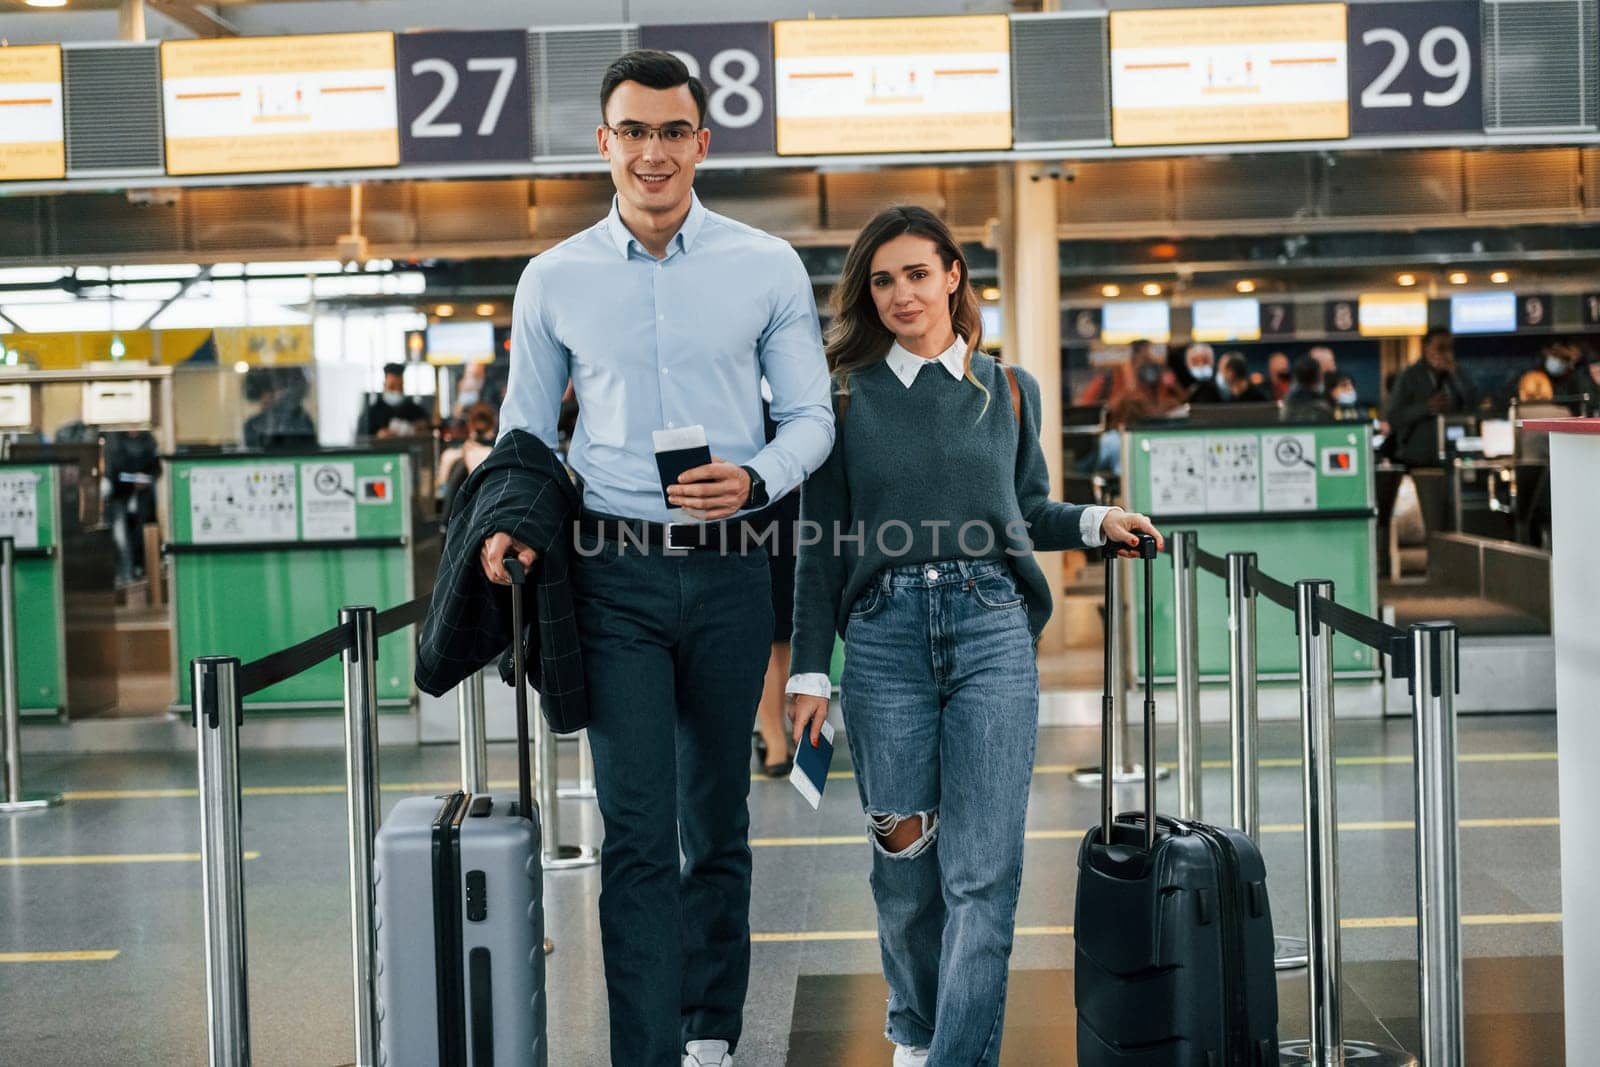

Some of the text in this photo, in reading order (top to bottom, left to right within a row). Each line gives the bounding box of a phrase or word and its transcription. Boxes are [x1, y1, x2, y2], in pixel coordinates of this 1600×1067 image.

[1361, 26, 1471, 108] 29
[411, 57, 517, 138] 27
[1269, 305, 1285, 332] 7
[1524, 297, 1544, 325] 9
